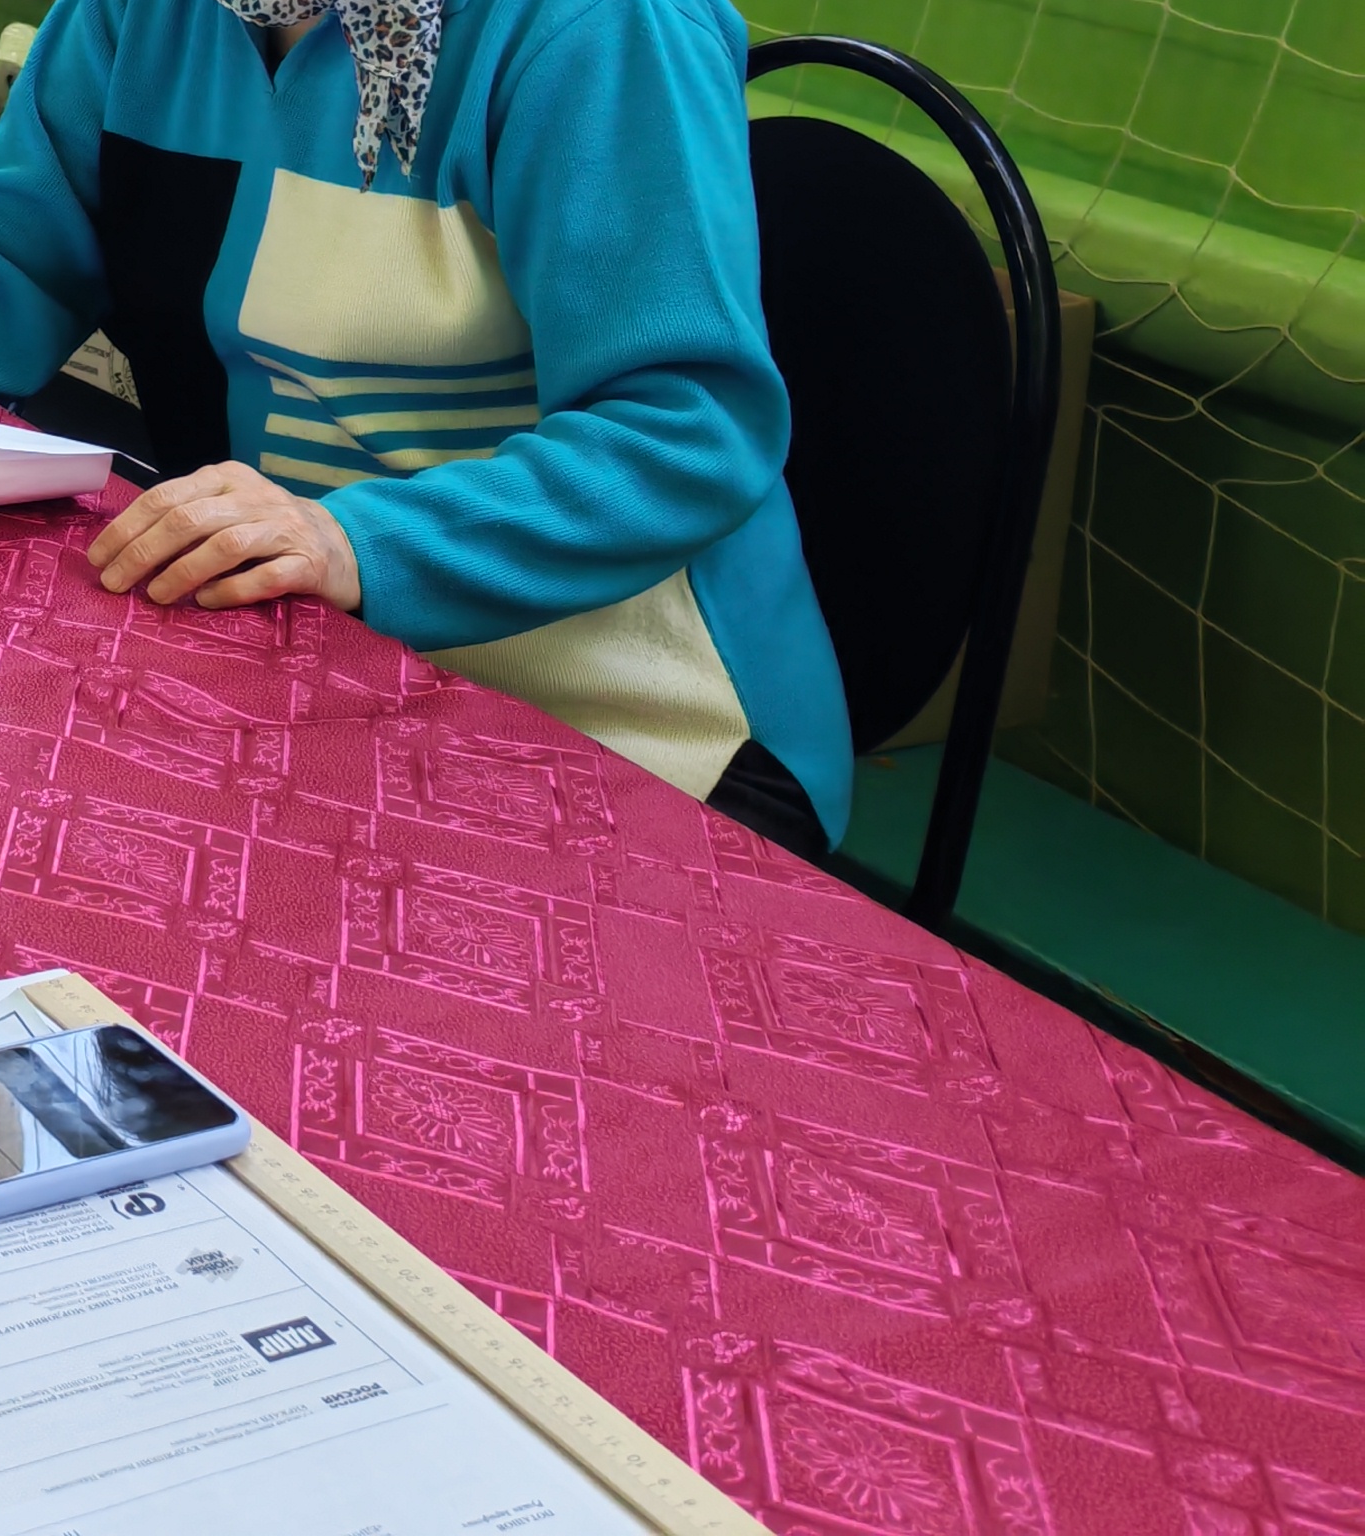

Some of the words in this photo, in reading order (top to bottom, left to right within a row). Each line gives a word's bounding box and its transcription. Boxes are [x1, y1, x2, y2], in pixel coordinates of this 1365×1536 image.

[125, 1193, 165, 1216] СР
[185, 1251, 223, 1266] ЛЮДИ
[187, 1258, 234, 1275] НОВЫЕ
[253, 1326, 319, 1356] ЛДПР
[322, 1383, 381, 1403] РОССИЯ
